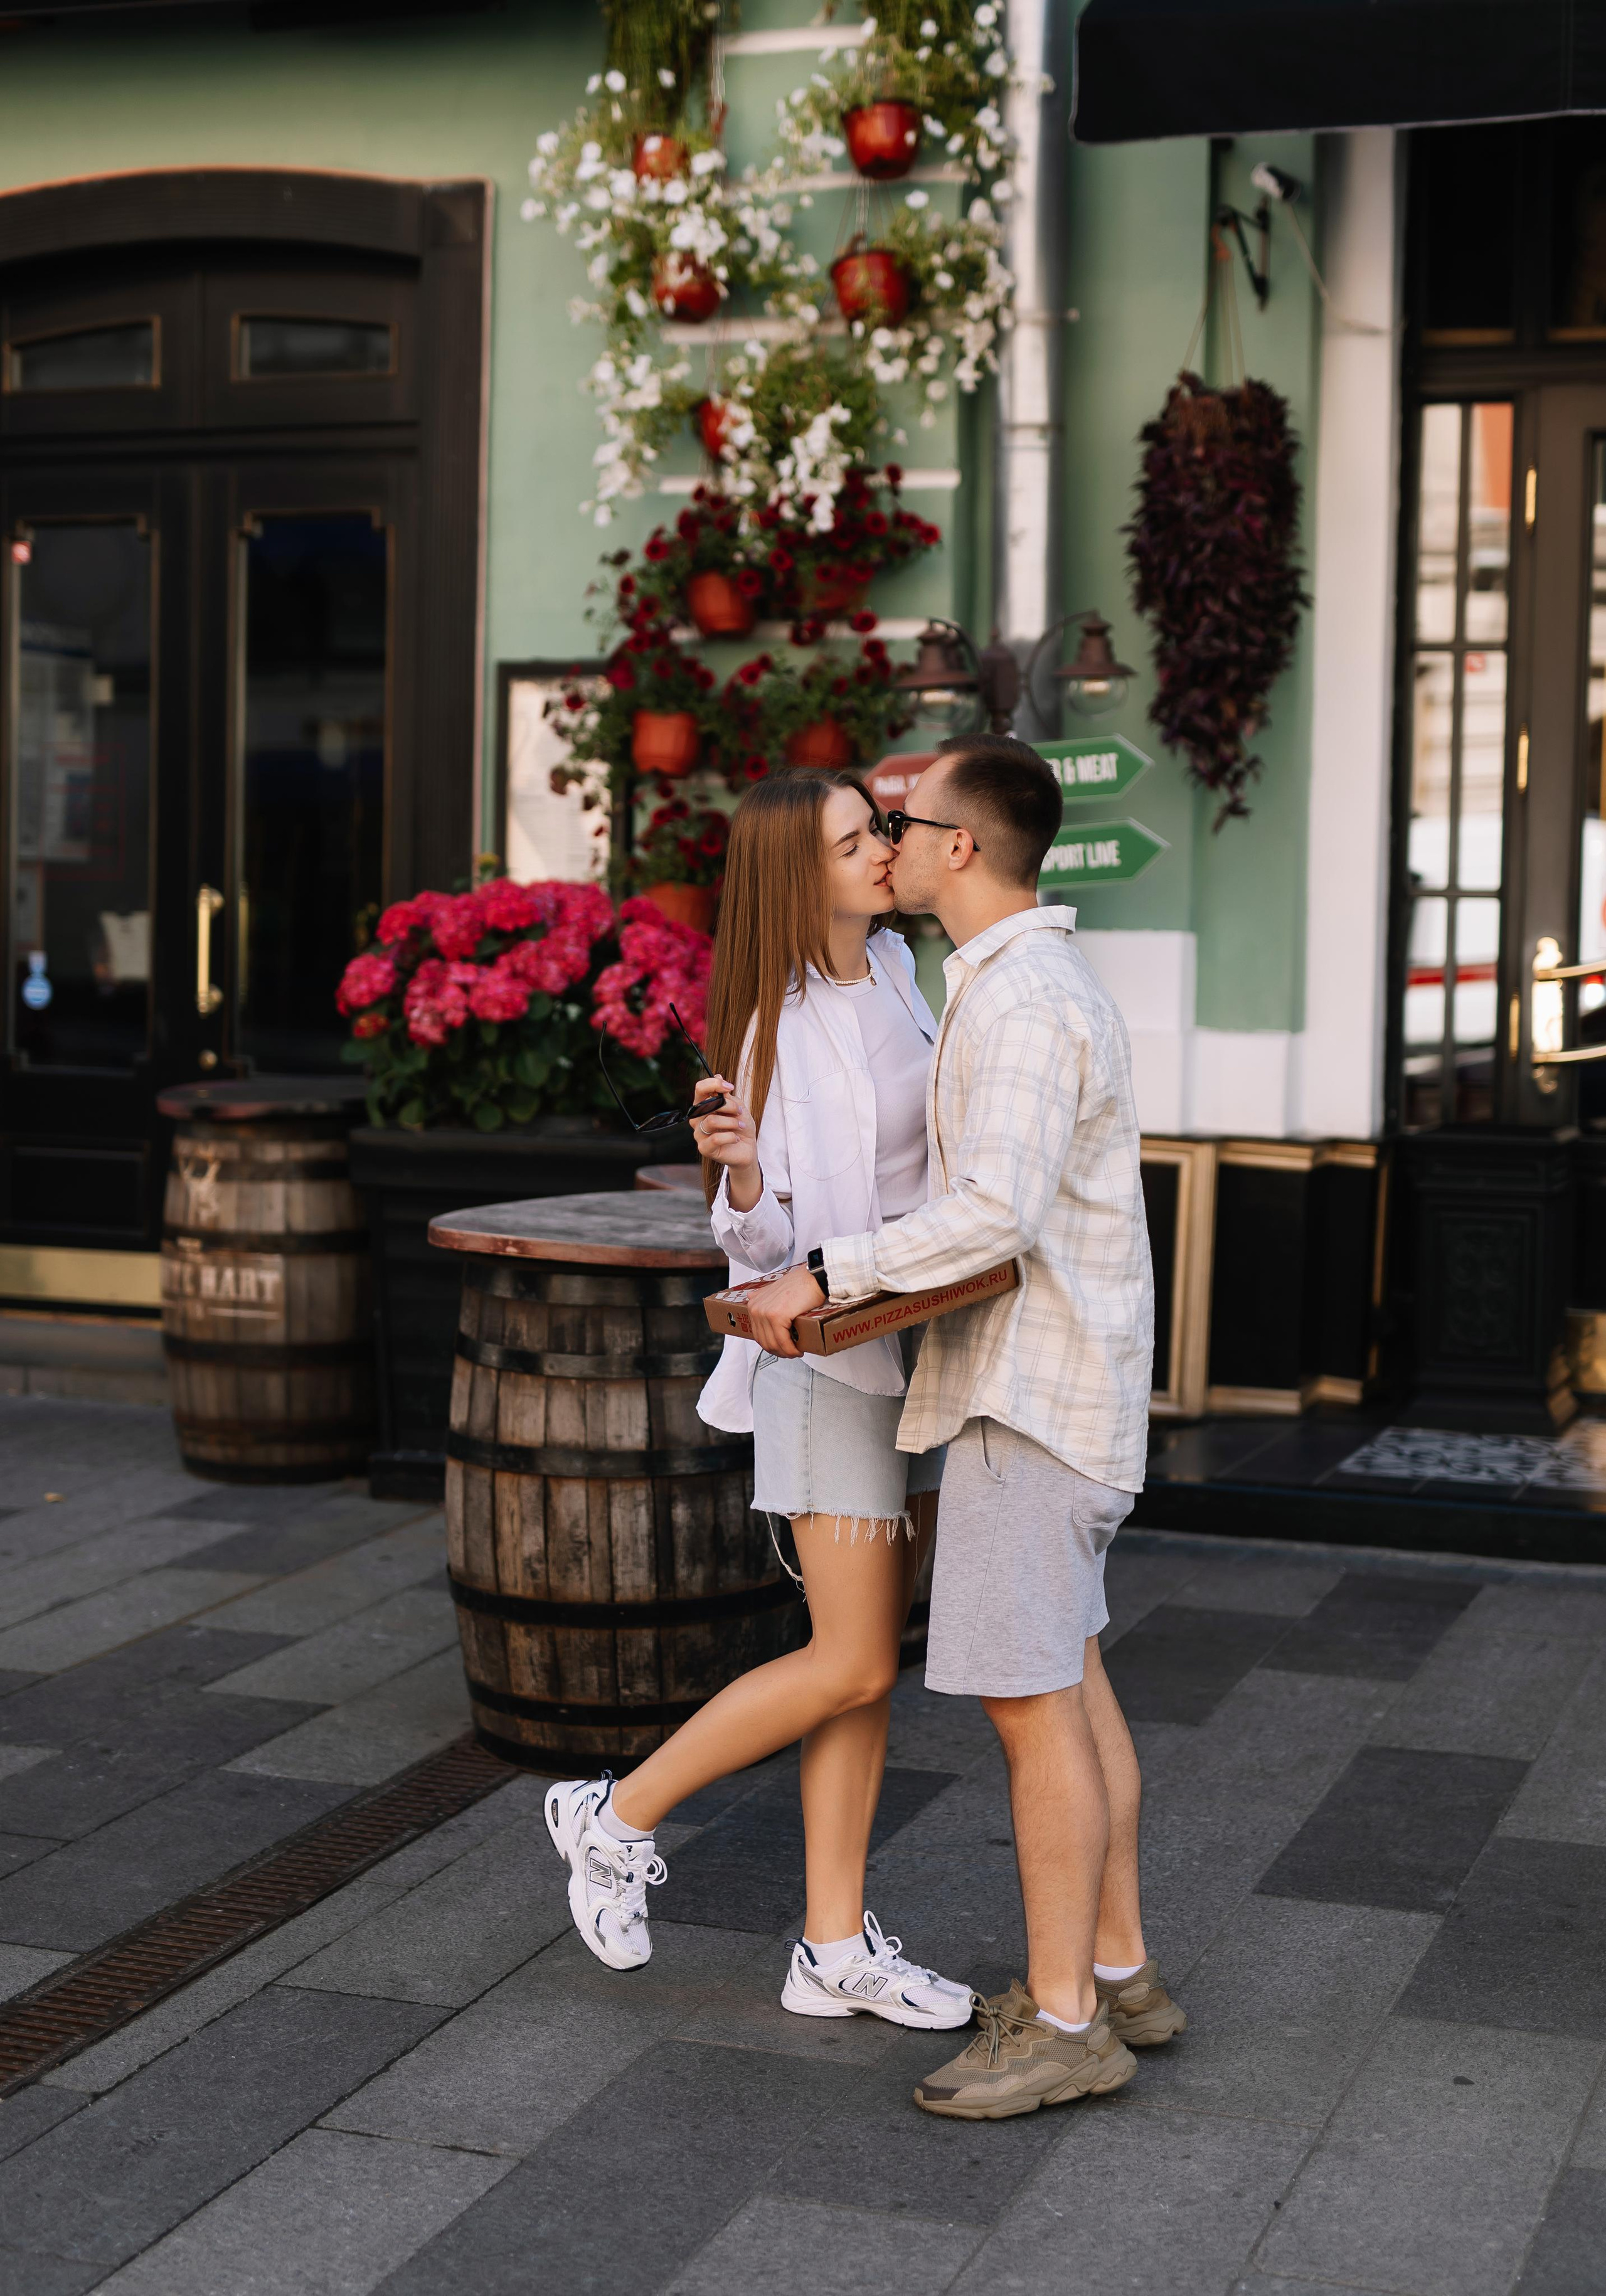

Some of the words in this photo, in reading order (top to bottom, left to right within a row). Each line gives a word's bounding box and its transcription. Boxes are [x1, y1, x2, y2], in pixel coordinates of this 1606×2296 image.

[1076, 752, 1119, 784] MEAT
[1086, 839, 1122, 869] LIVE
[832, 1269, 1008, 1344] WWW.PIZZASUSHIWOK.RU
[590, 1858, 612, 1889] N
[852, 1973, 888, 1998] N
